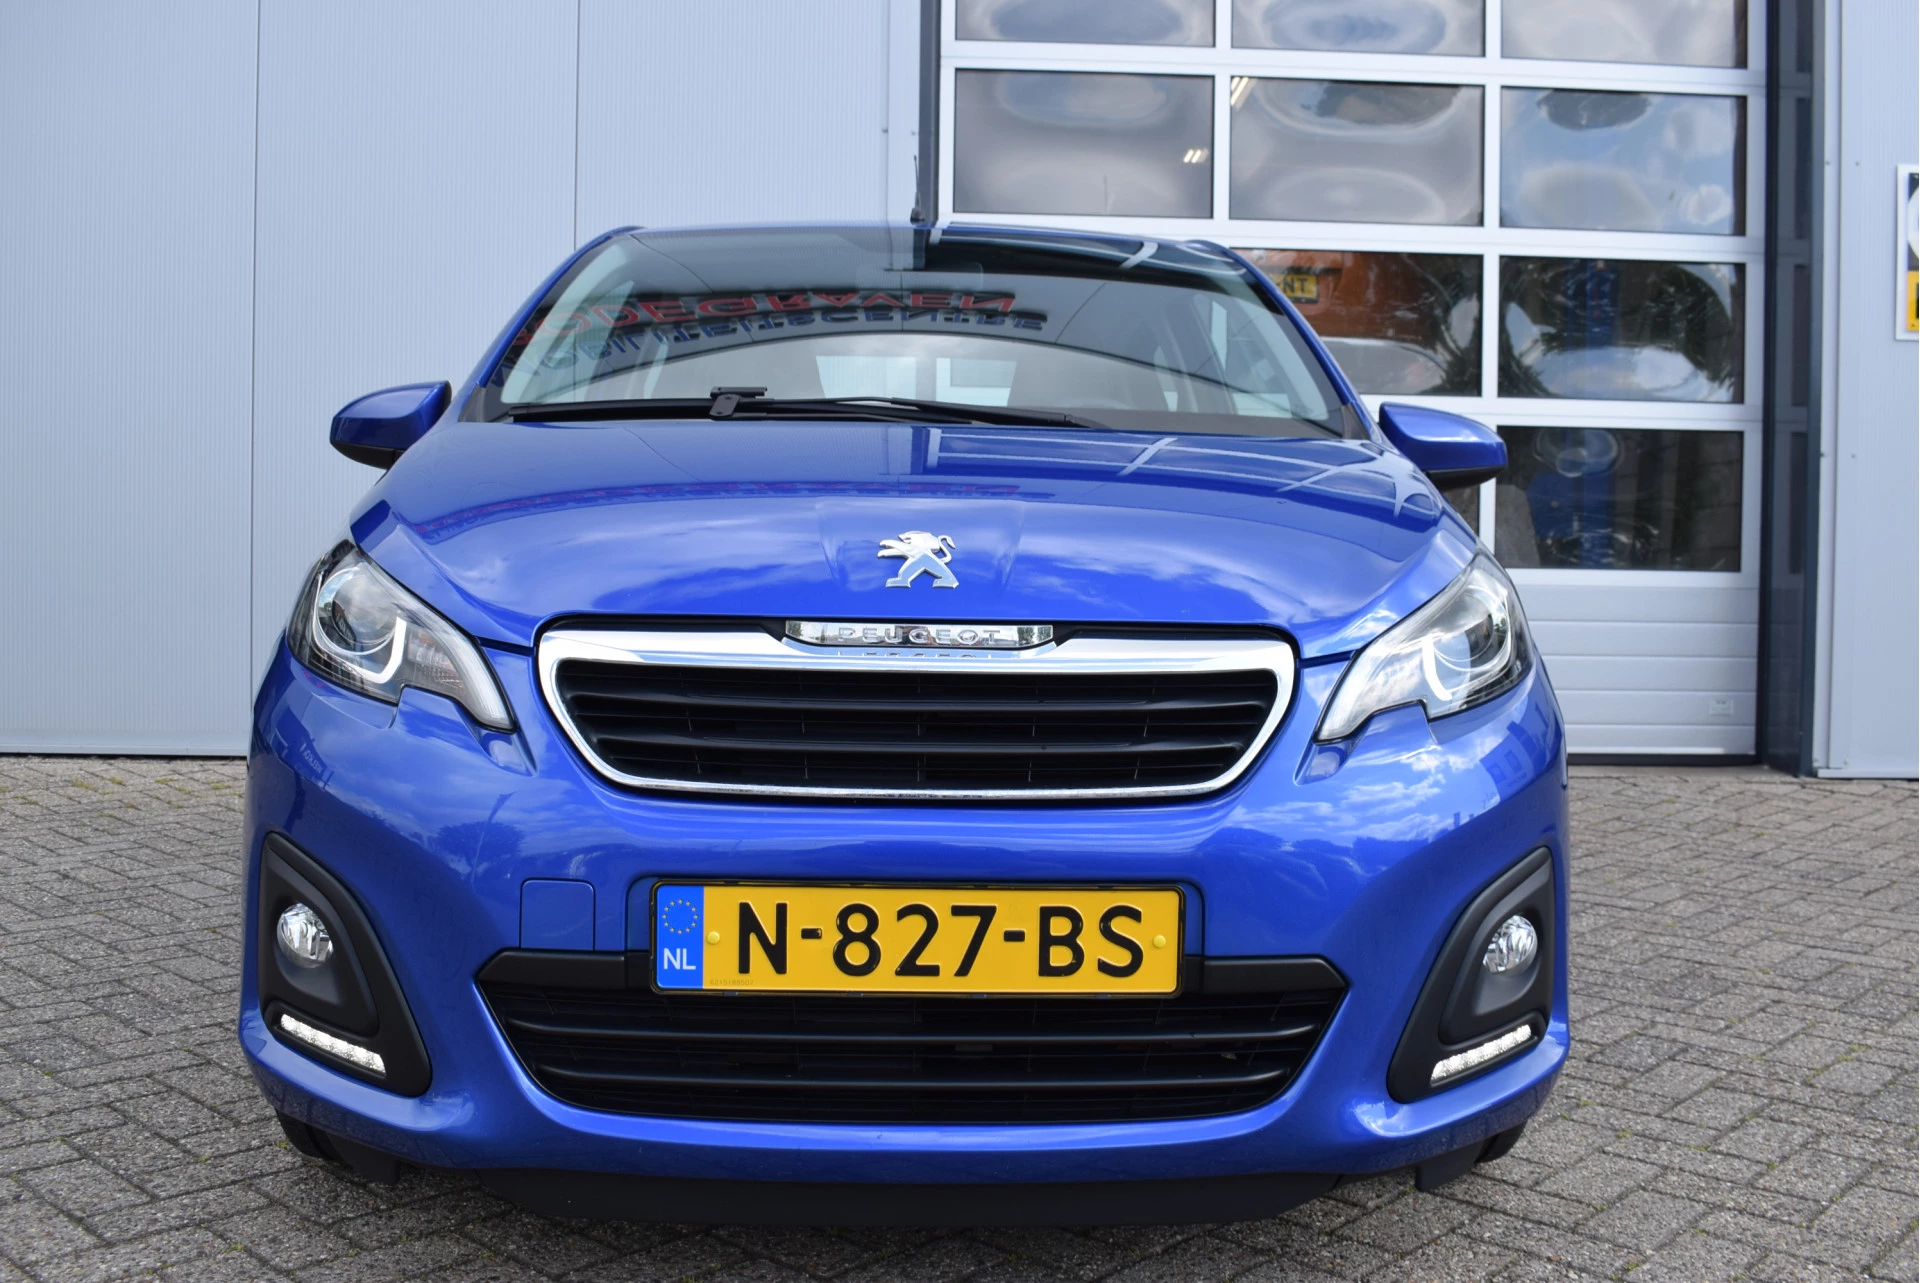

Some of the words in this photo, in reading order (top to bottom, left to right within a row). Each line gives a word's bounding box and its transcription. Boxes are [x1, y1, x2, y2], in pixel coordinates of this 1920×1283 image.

[837, 626, 1001, 646] PEUGEOT
[737, 901, 1145, 978] N-827-BS
[663, 948, 697, 971] NL
